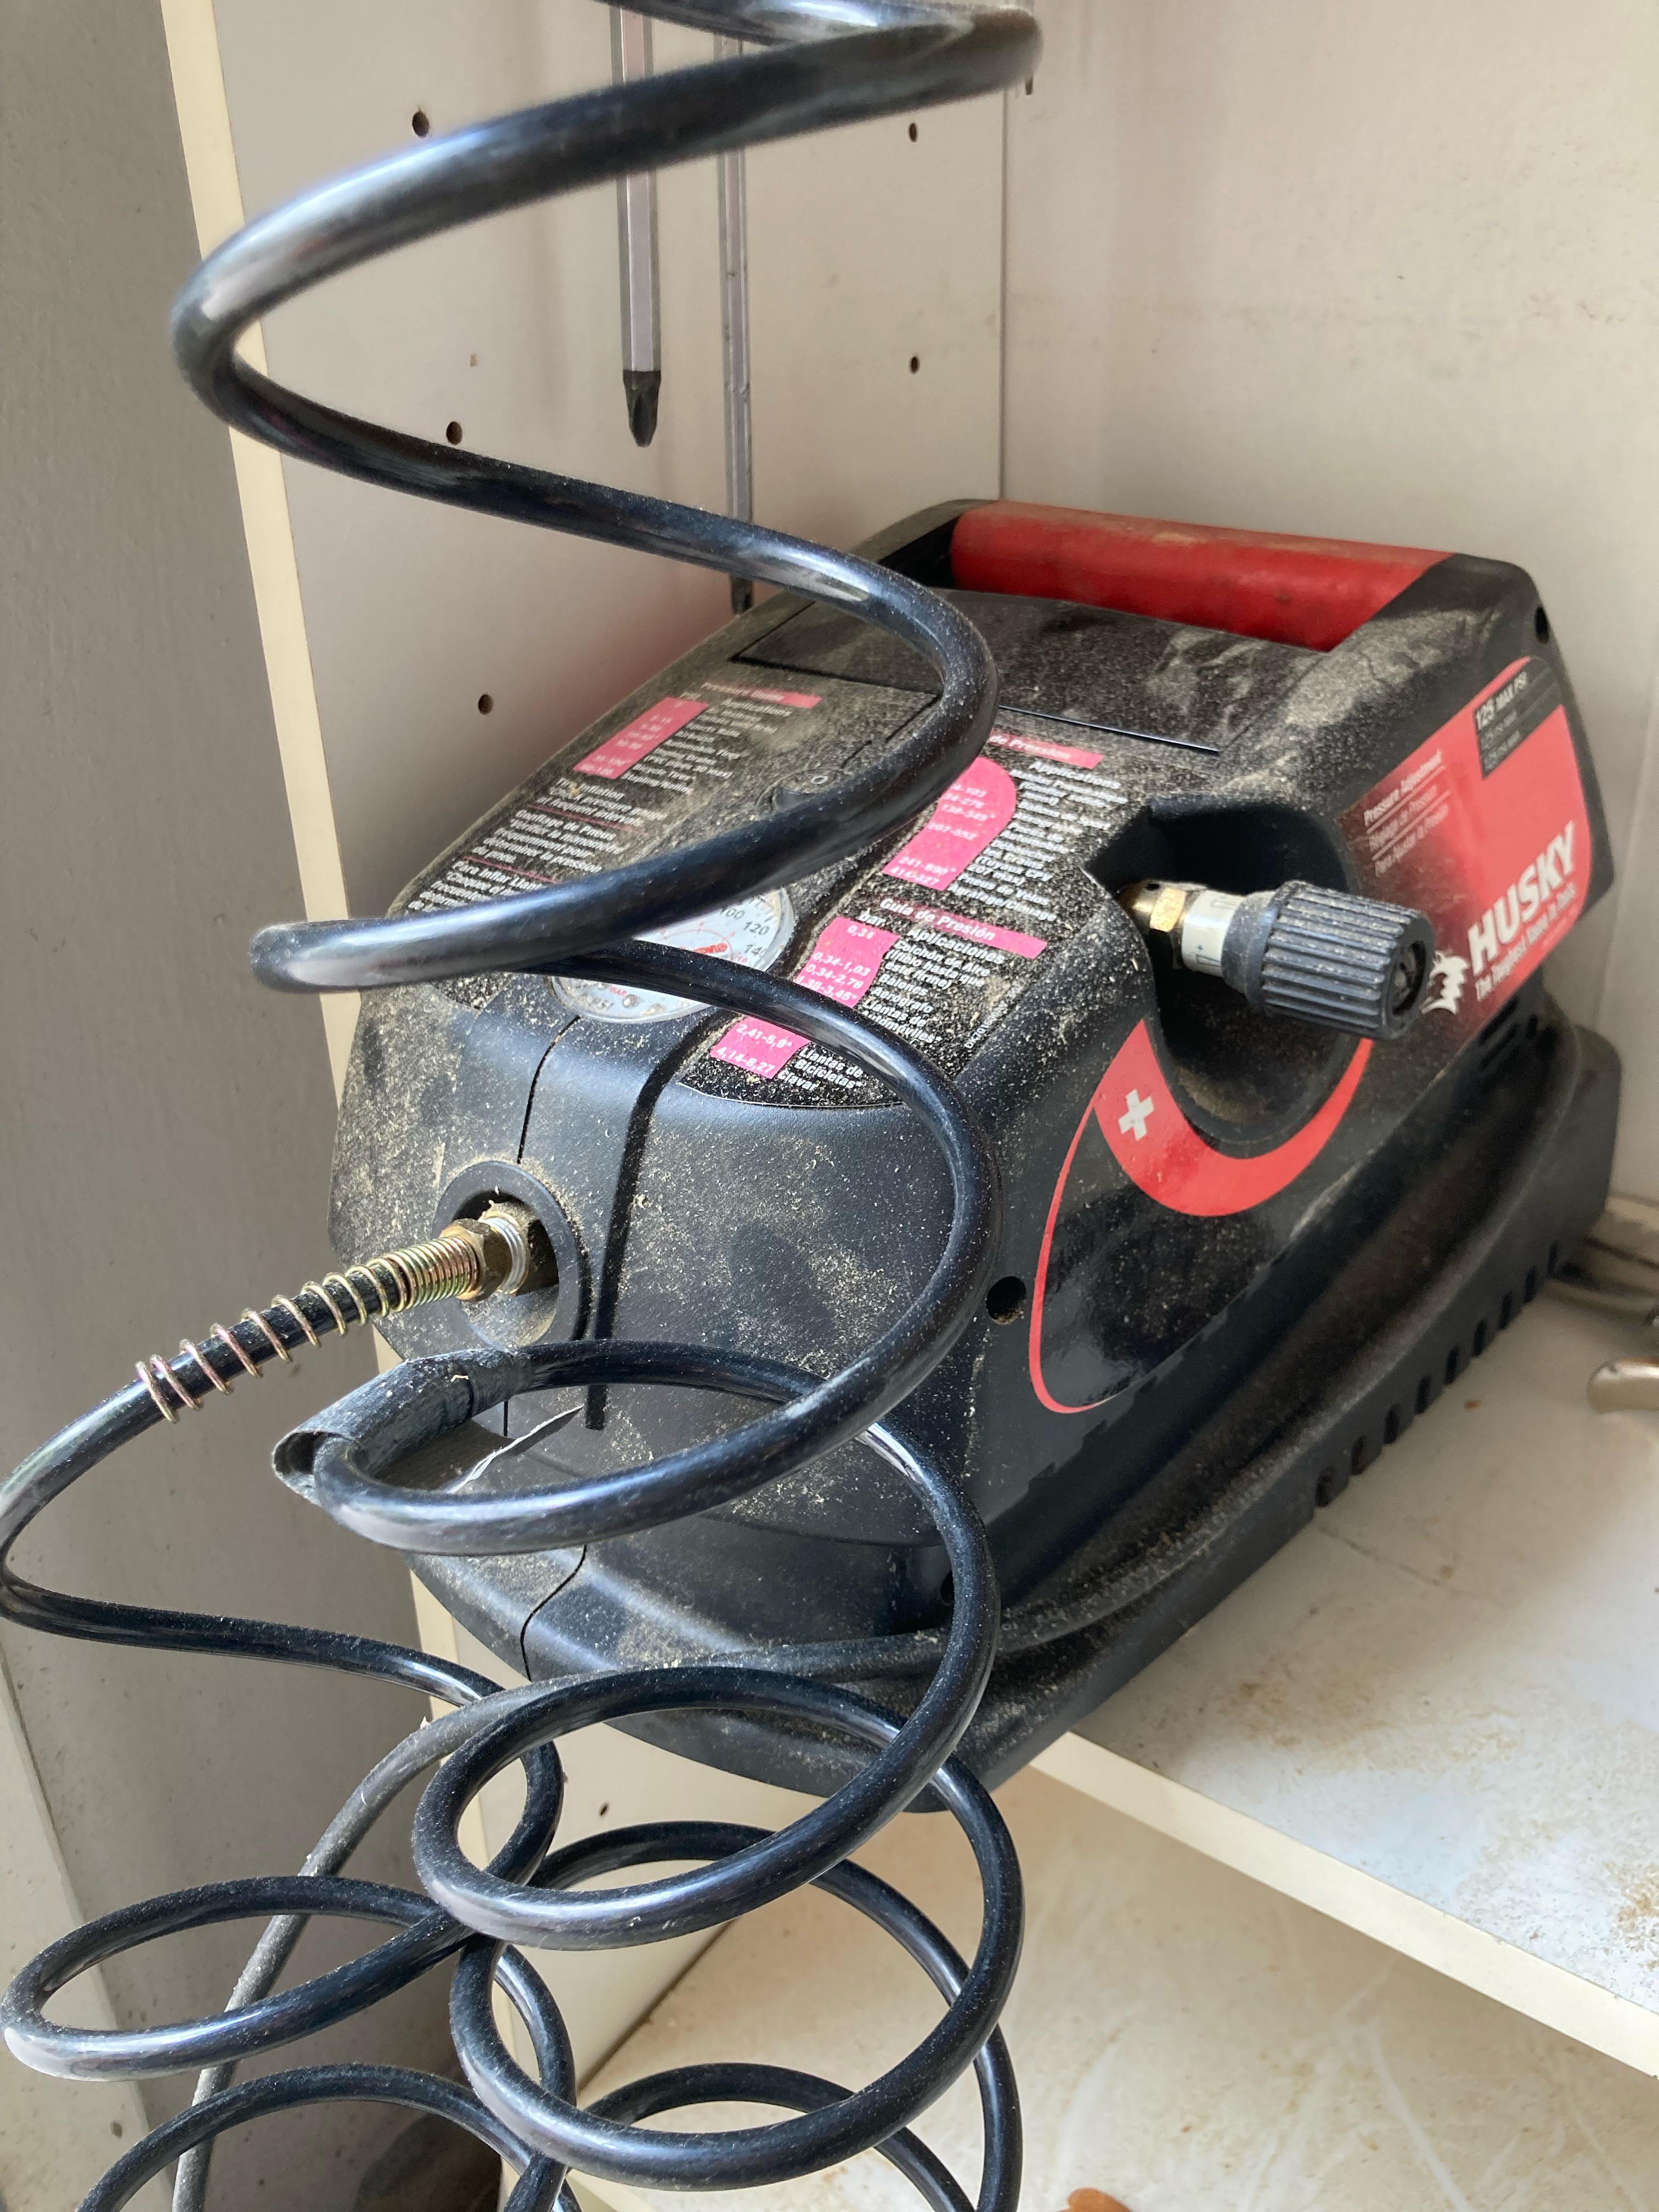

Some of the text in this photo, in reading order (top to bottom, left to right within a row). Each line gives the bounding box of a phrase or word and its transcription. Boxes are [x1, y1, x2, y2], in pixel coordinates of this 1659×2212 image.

[1028, 760, 1122, 790] Applications
[957, 873, 998, 891] Pneus
[996, 884, 1015, 896] de
[1024, 868, 1054, 882] CPV
[1467, 819, 1575, 977] HUSKY
[742, 921, 770, 936] 120
[914, 909, 937, 923] de
[936, 915, 997, 941] Presión
[906, 928, 1006, 965] Aplicaciones
[912, 967, 952, 991] firme)
[923, 961, 960, 979] hasta
[961, 962, 991, 978] Aire
[878, 972, 929, 997] Balones
[862, 998, 928, 1028] Llantas de
[715, 1046, 864, 1078] 4,14-8,27 Llantas de
[777, 1069, 820, 1092] Clavar
